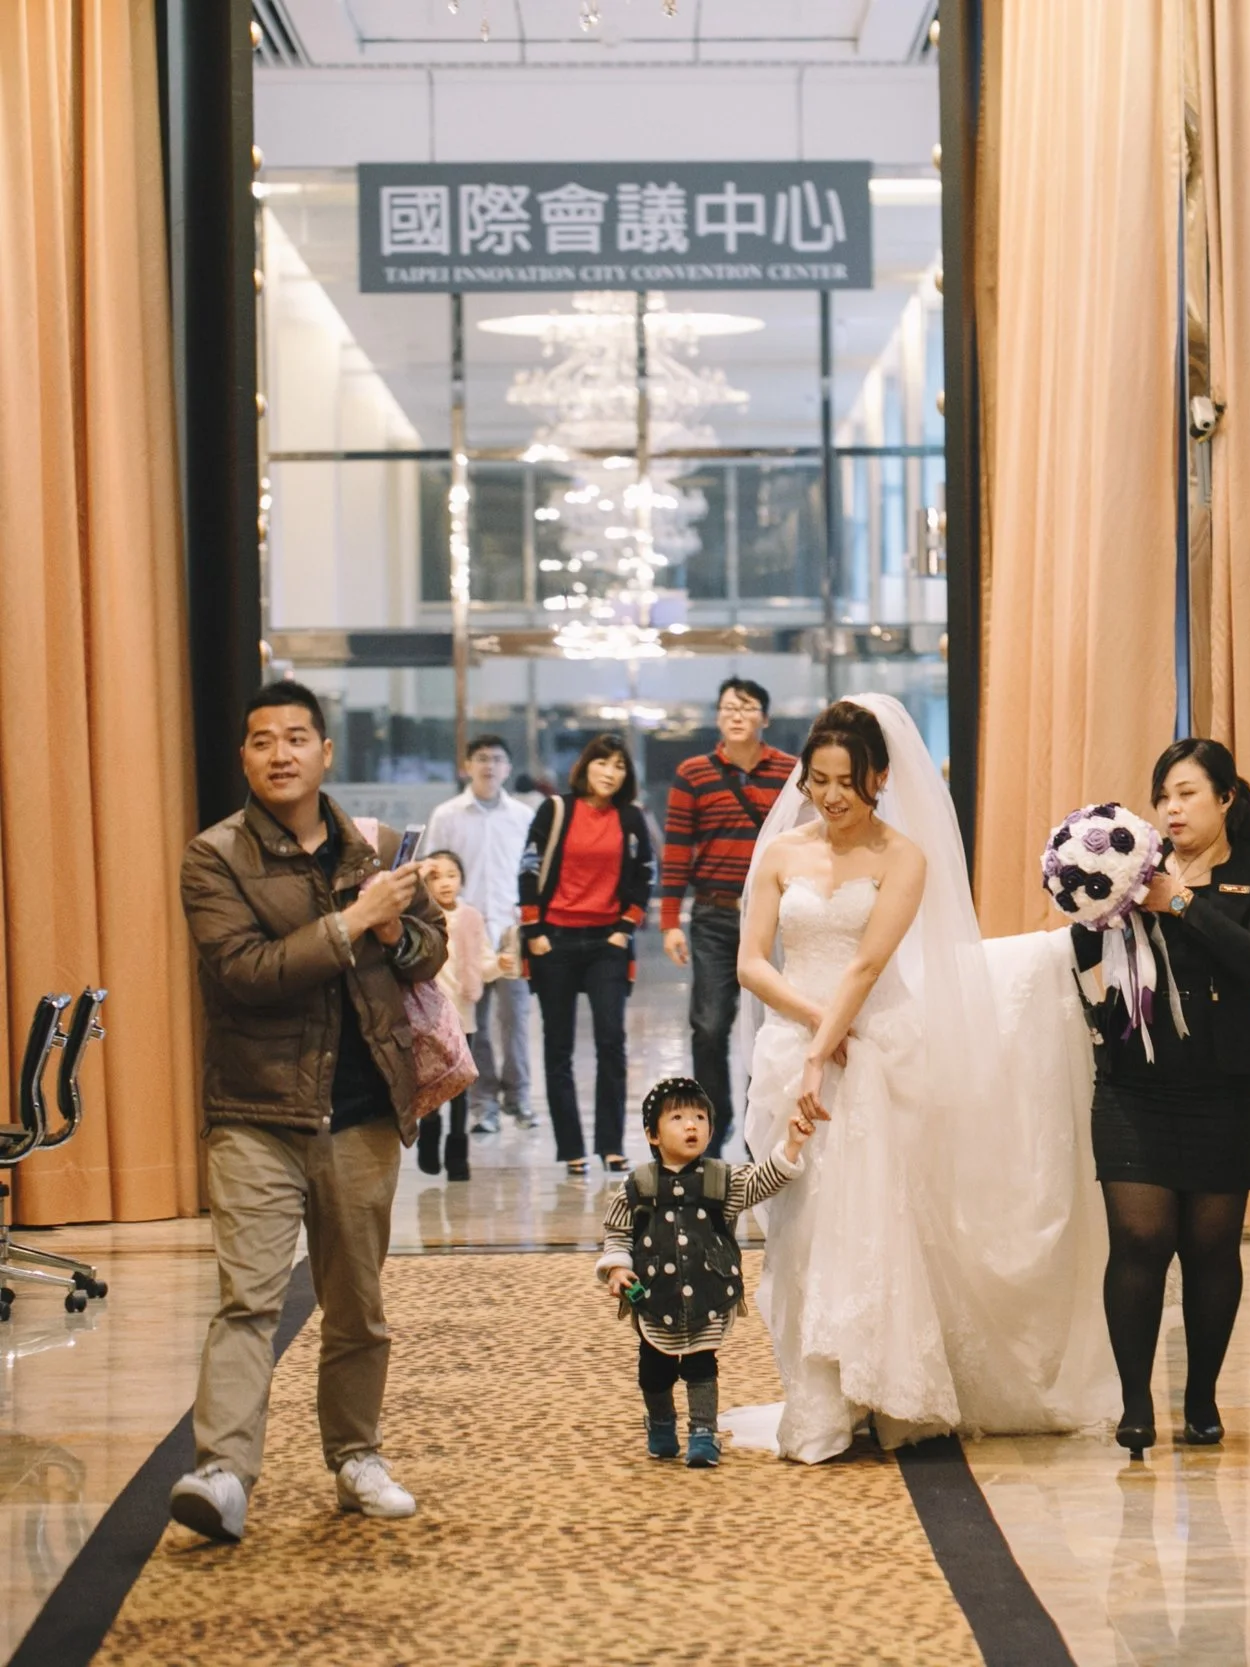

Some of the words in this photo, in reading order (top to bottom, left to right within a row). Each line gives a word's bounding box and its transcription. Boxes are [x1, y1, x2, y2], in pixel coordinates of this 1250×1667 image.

[380, 181, 847, 256] 國際會議中心
[384, 266, 449, 283] TAIPEI
[453, 265, 575, 283] INNOVATION
[579, 265, 626, 282] CITY
[631, 264, 763, 282] CONVENTION
[767, 263, 848, 281] CENTER
